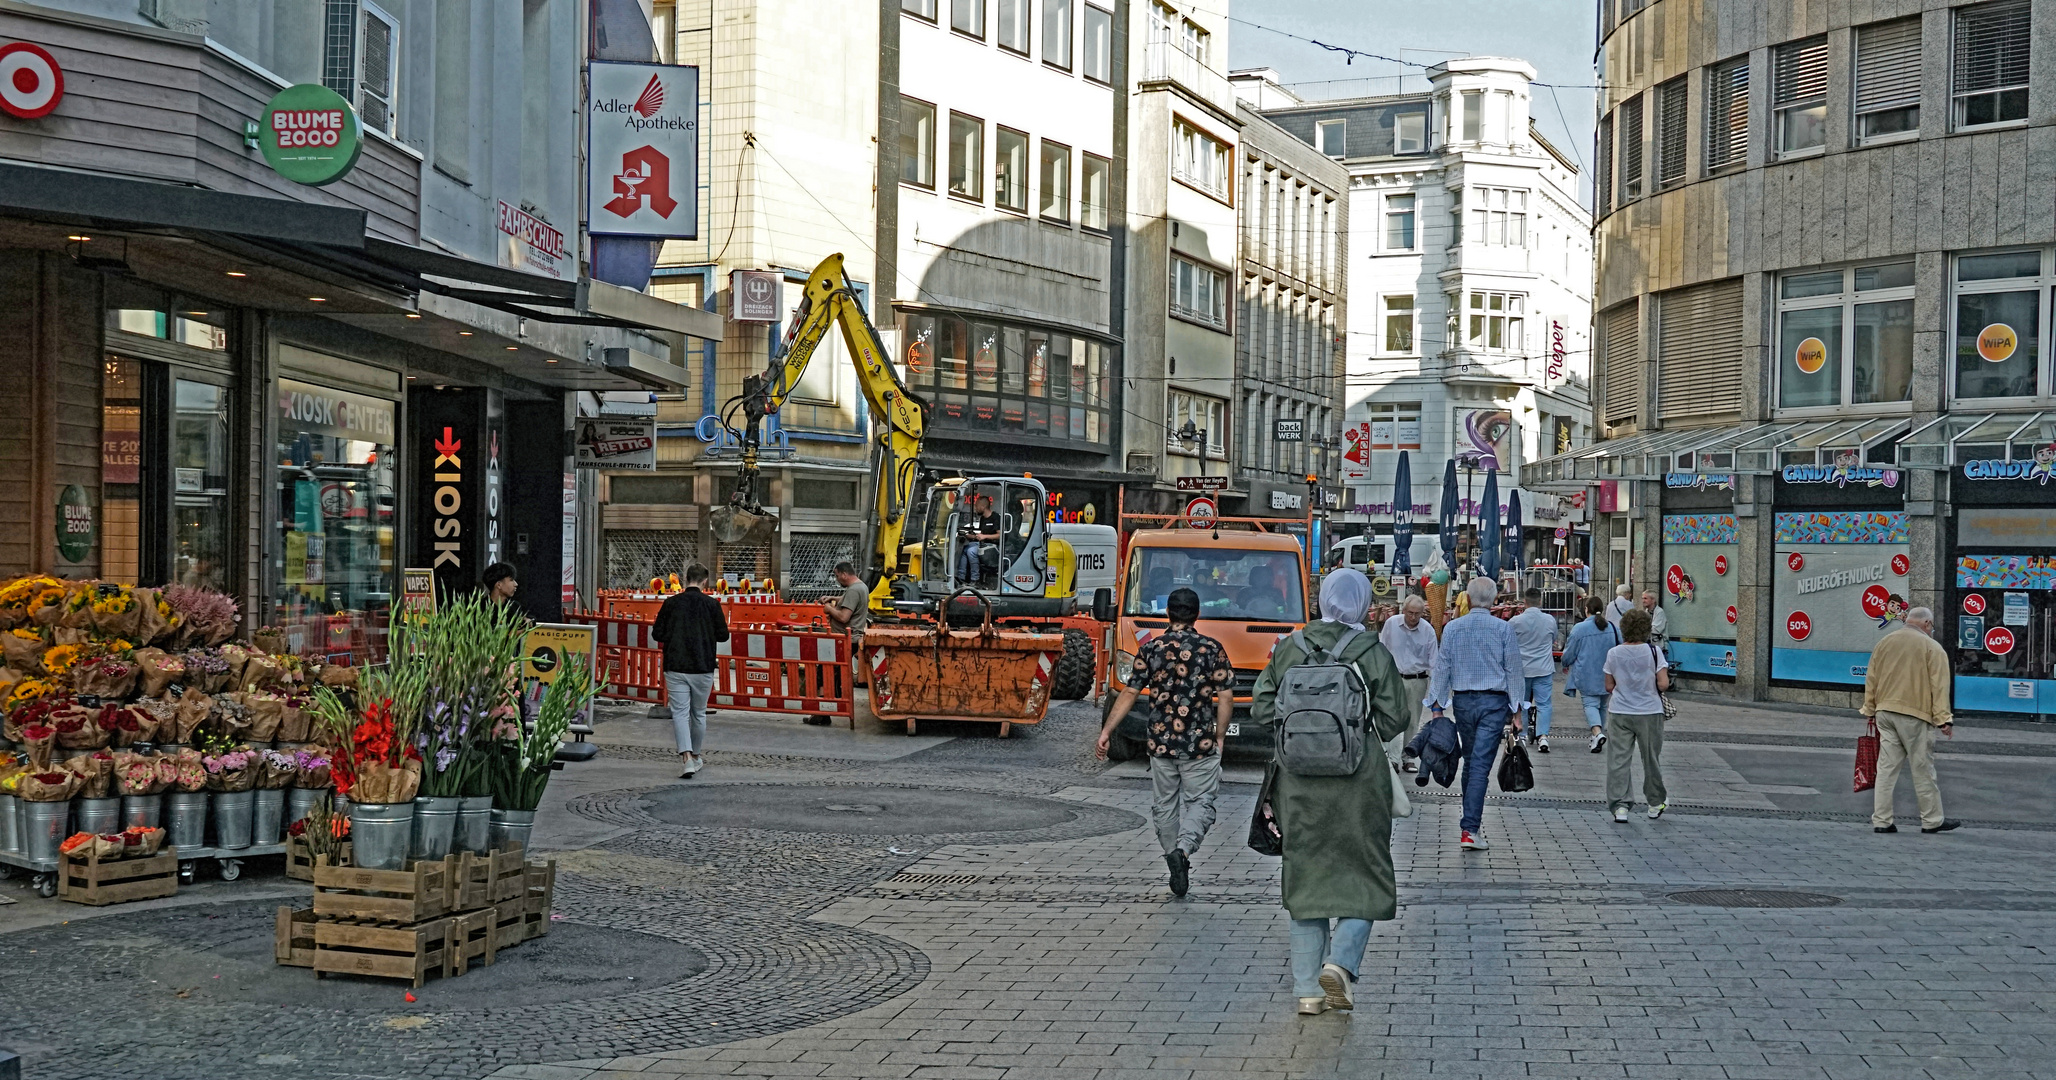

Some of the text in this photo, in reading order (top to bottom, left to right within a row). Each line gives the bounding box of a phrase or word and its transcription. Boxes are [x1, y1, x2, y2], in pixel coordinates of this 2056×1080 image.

[593, 99, 633, 113] Adler
[274, 112, 342, 129] BLUME
[625, 115, 695, 132] Apotheke
[280, 130, 338, 146] 2000
[500, 203, 562, 258] FAHRSCHULE
[1548, 320, 1567, 380] Pieper
[280, 390, 393, 436] KIOSK CENTER
[1279, 422, 1300, 431] back
[1278, 432, 1301, 440] WERK
[120, 441, 140, 452] 20
[598, 438, 649, 453] RETTIG
[577, 461, 651, 469] FAHRSCHULE-RETTIG.DE
[1965, 460, 2037, 478] CANDY
[1666, 473, 1698, 486] CANDY
[1783, 465, 1884, 481] CANDY SALE
[1046, 492, 1062, 506] er
[64, 505, 92, 520] BLUME
[1046, 506, 1083, 523] ecker
[1354, 501, 1432, 515] PARFÜRIE
[67, 520, 91, 533] 2000
[1077, 553, 1105, 570] rmes
[1893, 557, 1906, 572] 30%
[406, 576, 430, 591] VAPES
[1668, 570, 1681, 589] 70%
[1797, 563, 1884, 595] NEUERÖFFNUNG!
[1865, 592, 1886, 611] 70%
[1966, 598, 1981, 611] 20%
[1789, 621, 1808, 630] 50%
[1988, 636, 2011, 646] 40%
